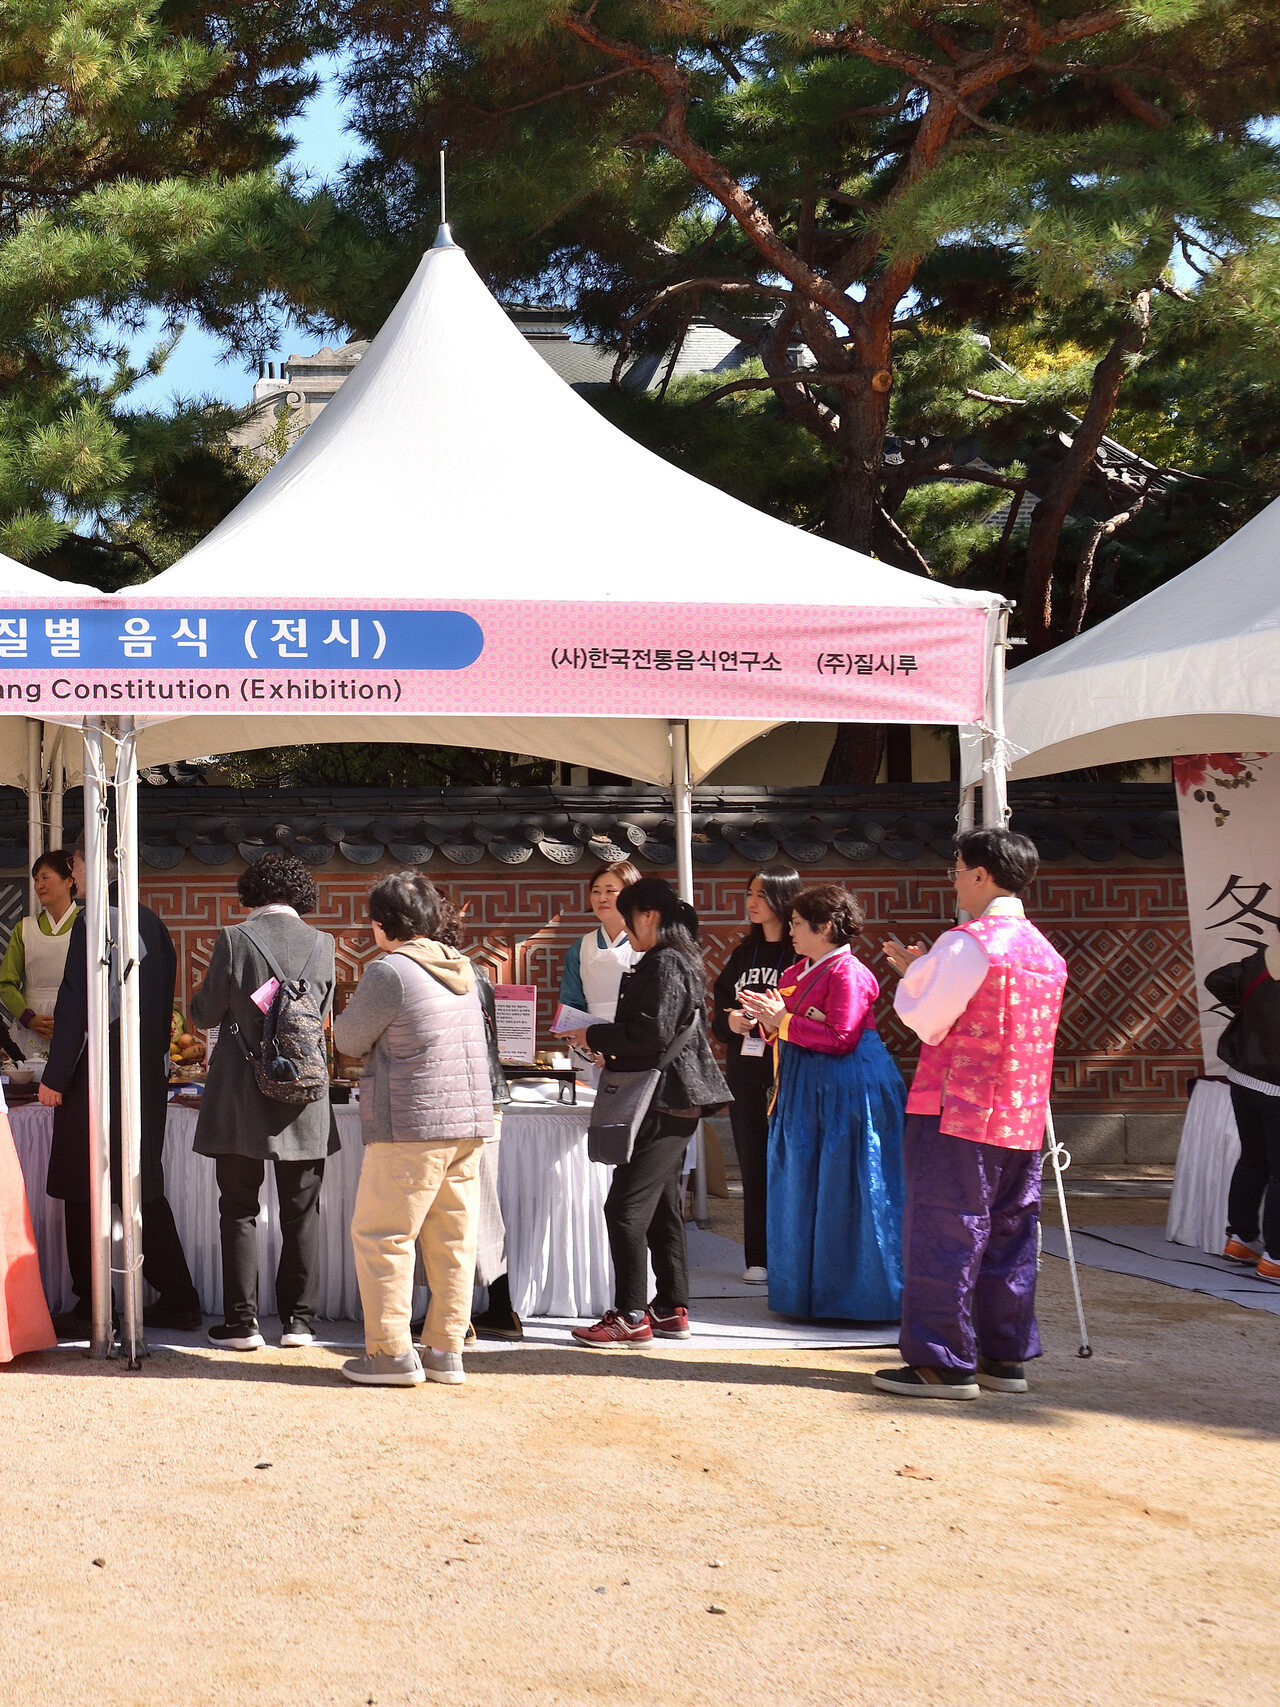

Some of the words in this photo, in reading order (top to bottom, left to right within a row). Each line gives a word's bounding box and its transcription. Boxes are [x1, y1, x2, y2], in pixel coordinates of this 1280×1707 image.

[118, 617, 207, 658] 음식
[244, 618, 387, 659] (전시)
[550, 647, 782, 673] (사)한국전통음식연구소
[817, 652, 918, 676] (주)질시루
[51, 678, 230, 700] Constitution
[240, 679, 402, 702] (Exhibition)
[734, 967, 784, 1001] HARVA
